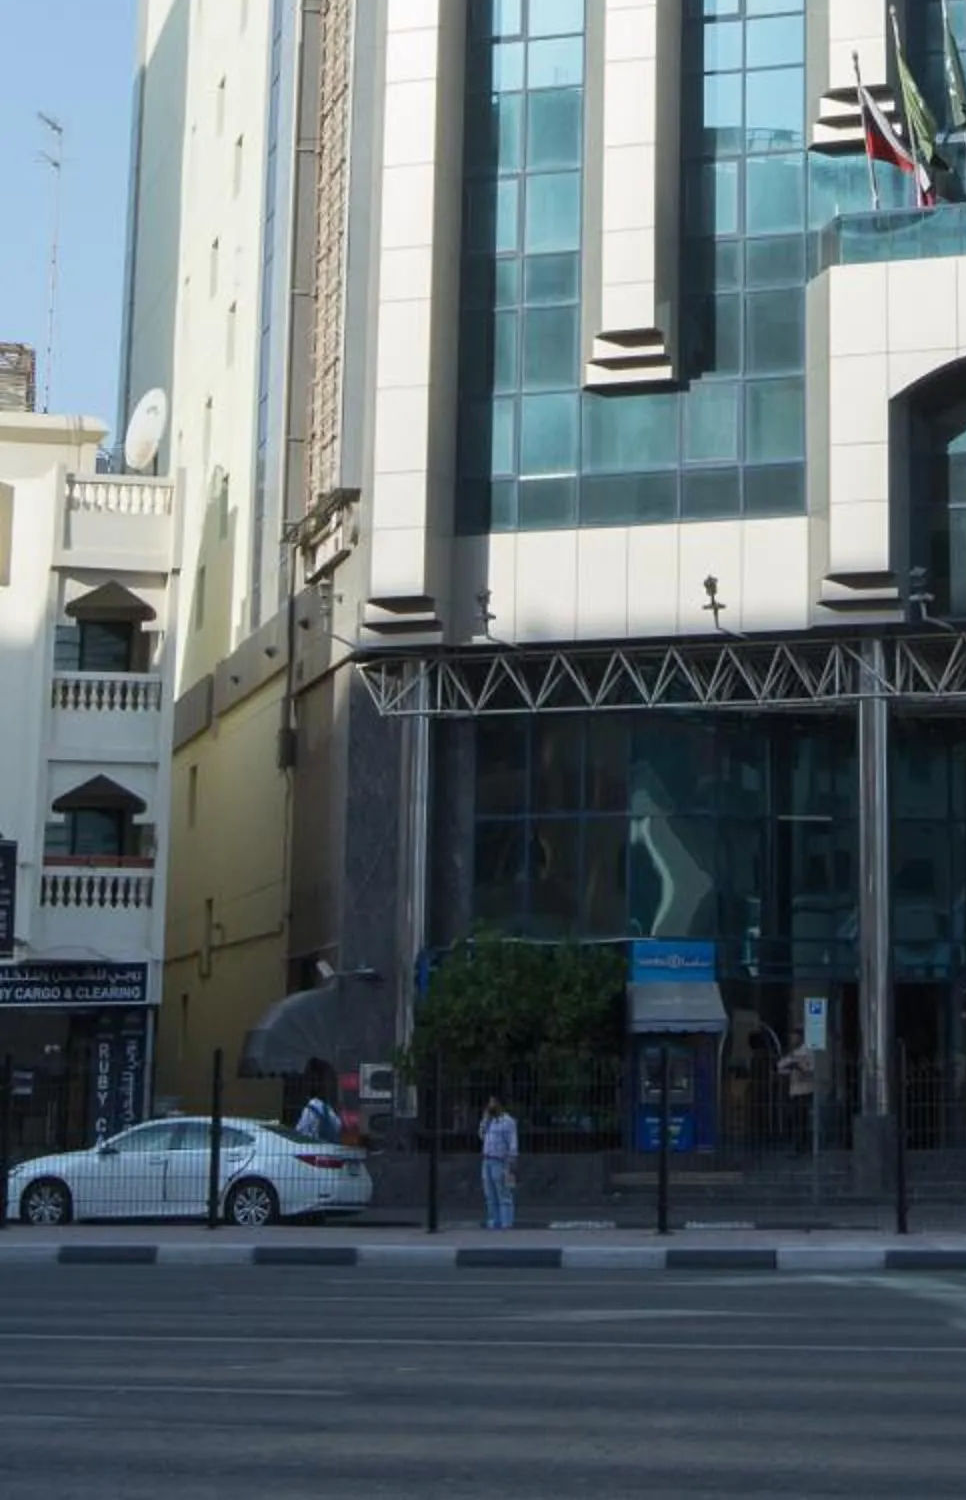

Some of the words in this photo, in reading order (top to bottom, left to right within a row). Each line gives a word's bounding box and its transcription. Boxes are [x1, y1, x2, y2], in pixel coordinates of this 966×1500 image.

[15, 987, 60, 1000] CARGO
[63, 987, 73, 1000] &
[75, 985, 141, 999] CLEARING
[97, 1042, 110, 1108] RUBY
